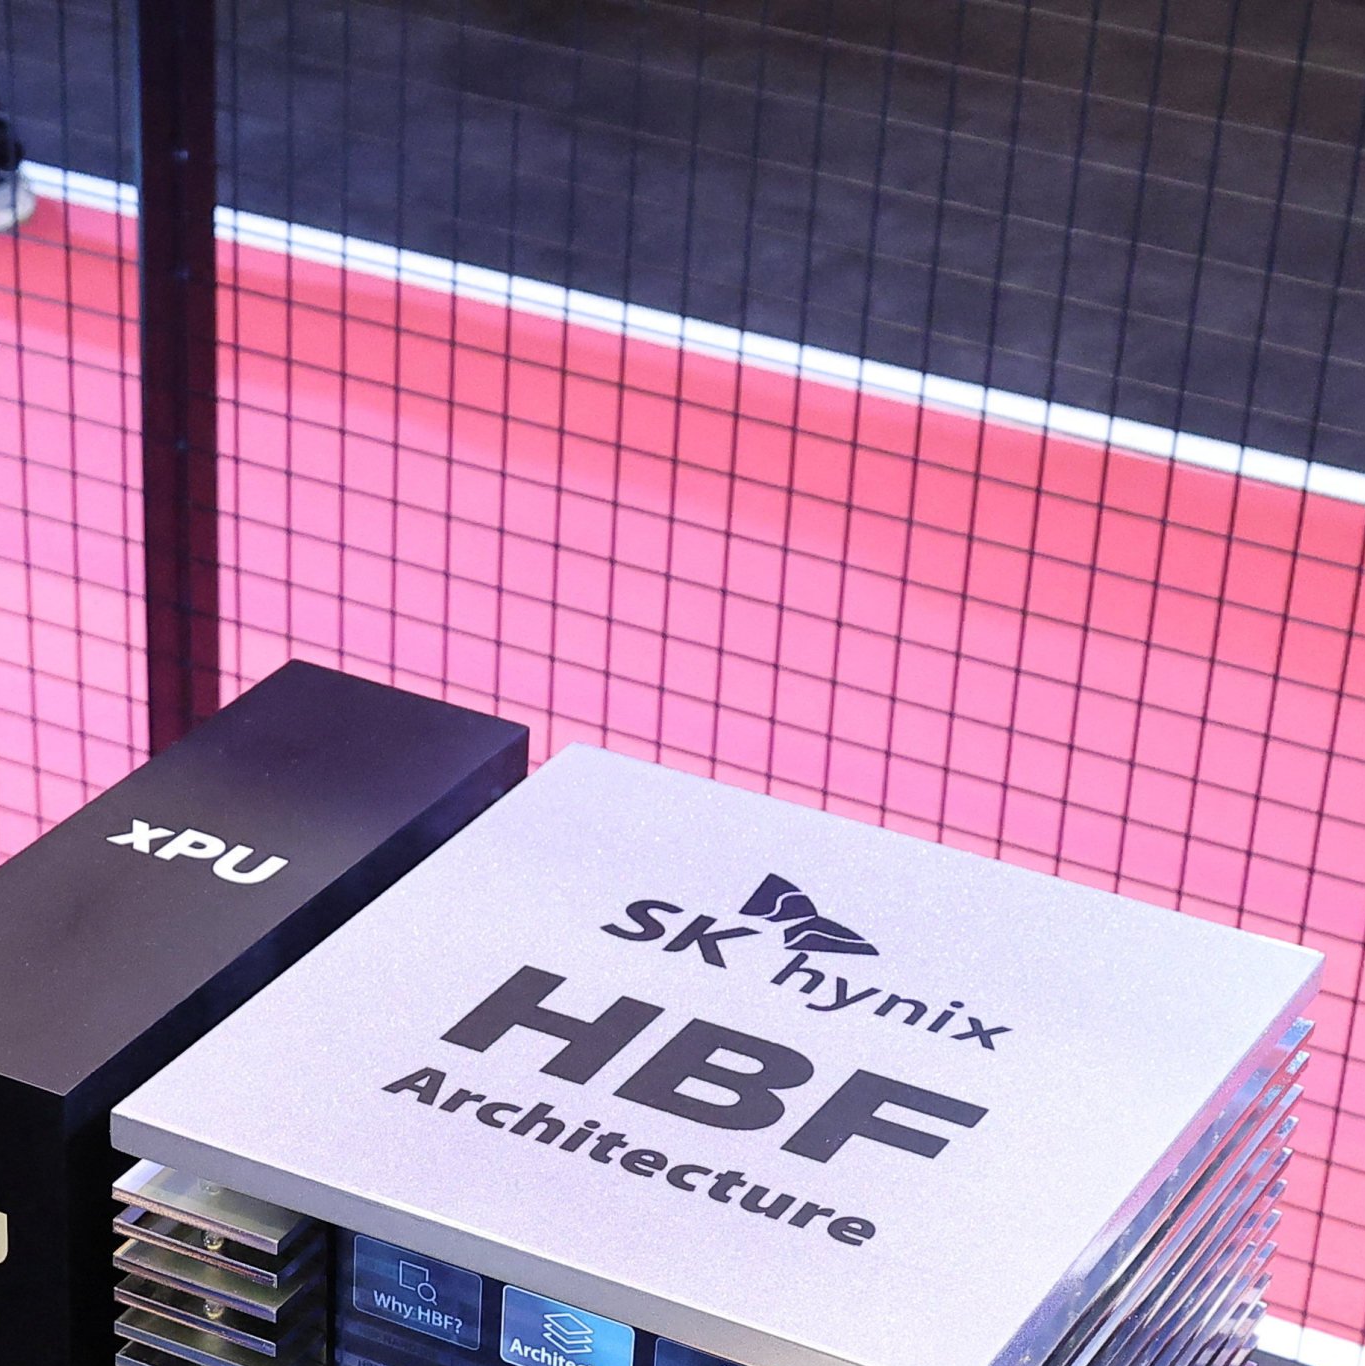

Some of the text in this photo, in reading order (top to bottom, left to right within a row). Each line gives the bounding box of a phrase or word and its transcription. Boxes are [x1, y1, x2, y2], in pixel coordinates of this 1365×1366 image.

[106, 819, 289, 884] xPU
[600, 899, 761, 969] SK
[770, 952, 1014, 1051] hynix
[439, 965, 990, 1164] HBF
[381, 1066, 876, 1247] Architecture
[373, 1290, 463, 1335] Why HBF?
